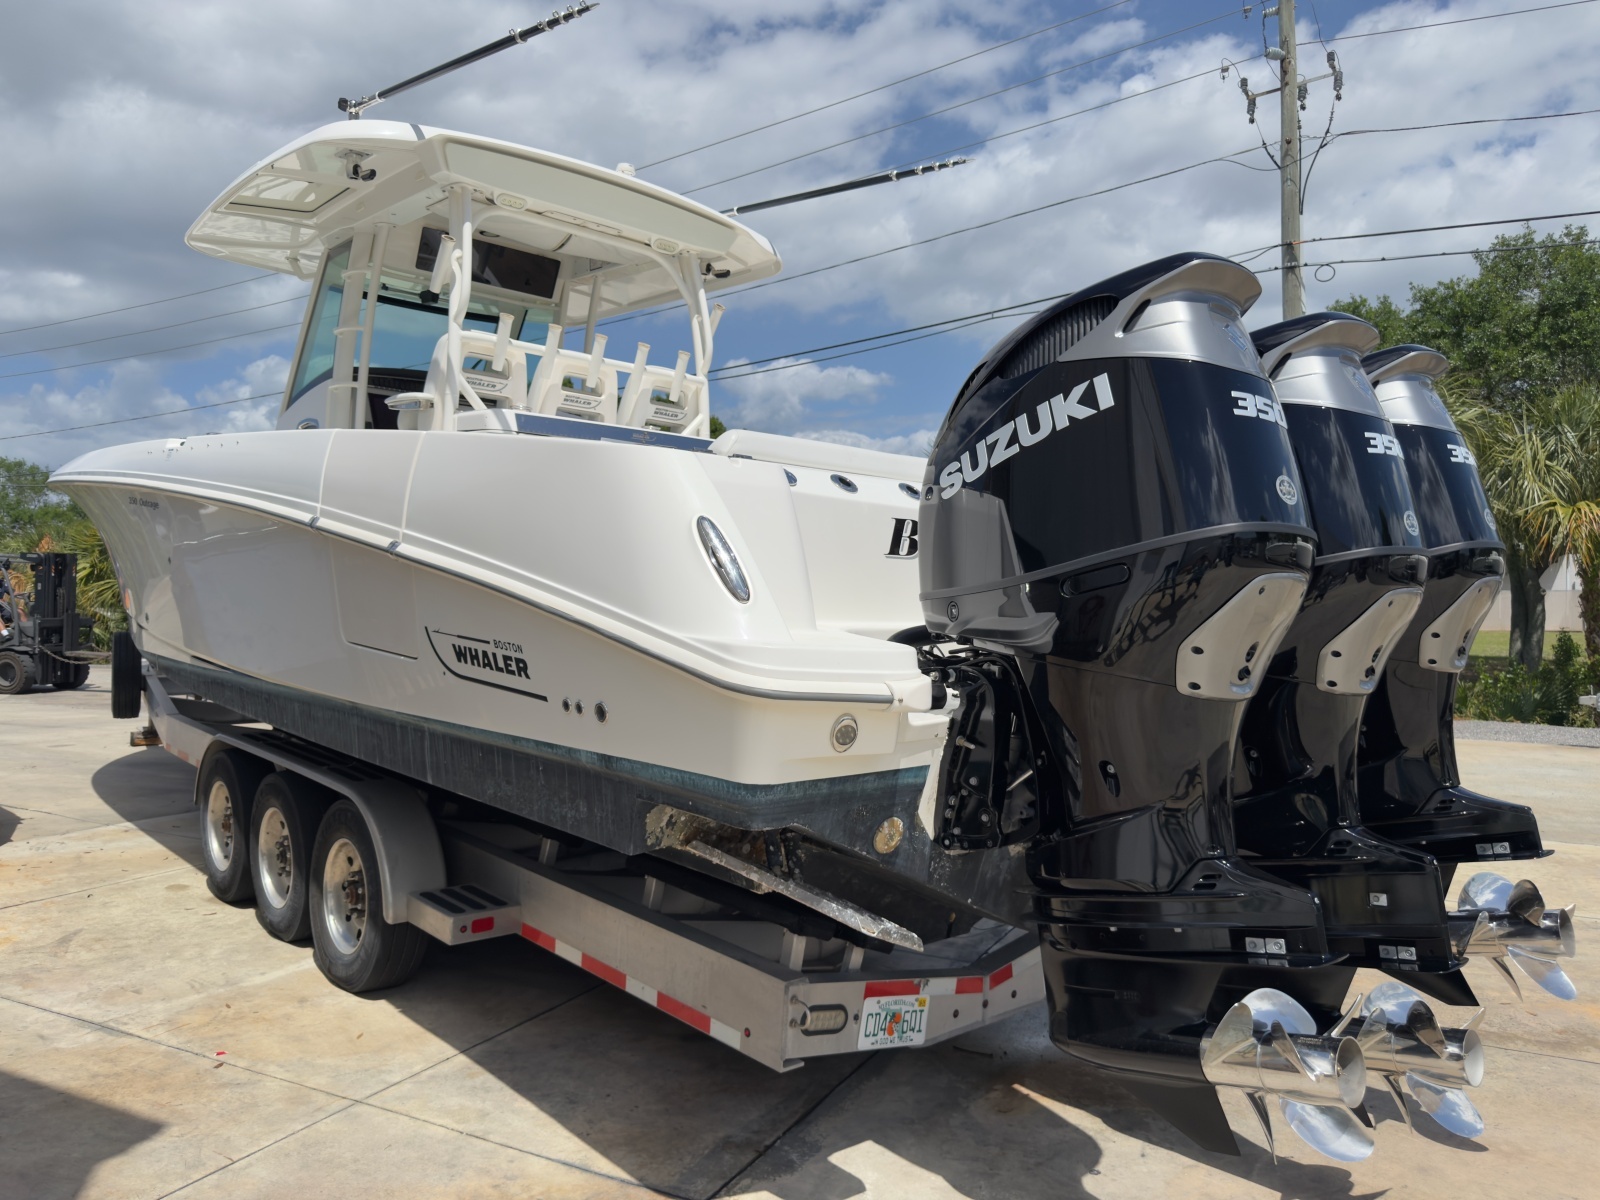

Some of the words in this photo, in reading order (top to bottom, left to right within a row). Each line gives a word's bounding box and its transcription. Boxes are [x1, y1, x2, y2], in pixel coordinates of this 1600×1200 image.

[1231, 391, 1288, 430] 350
[939, 372, 1115, 500] SUZUKI
[452, 643, 531, 680] WHALER
[493, 639, 523, 654] BOSTON
